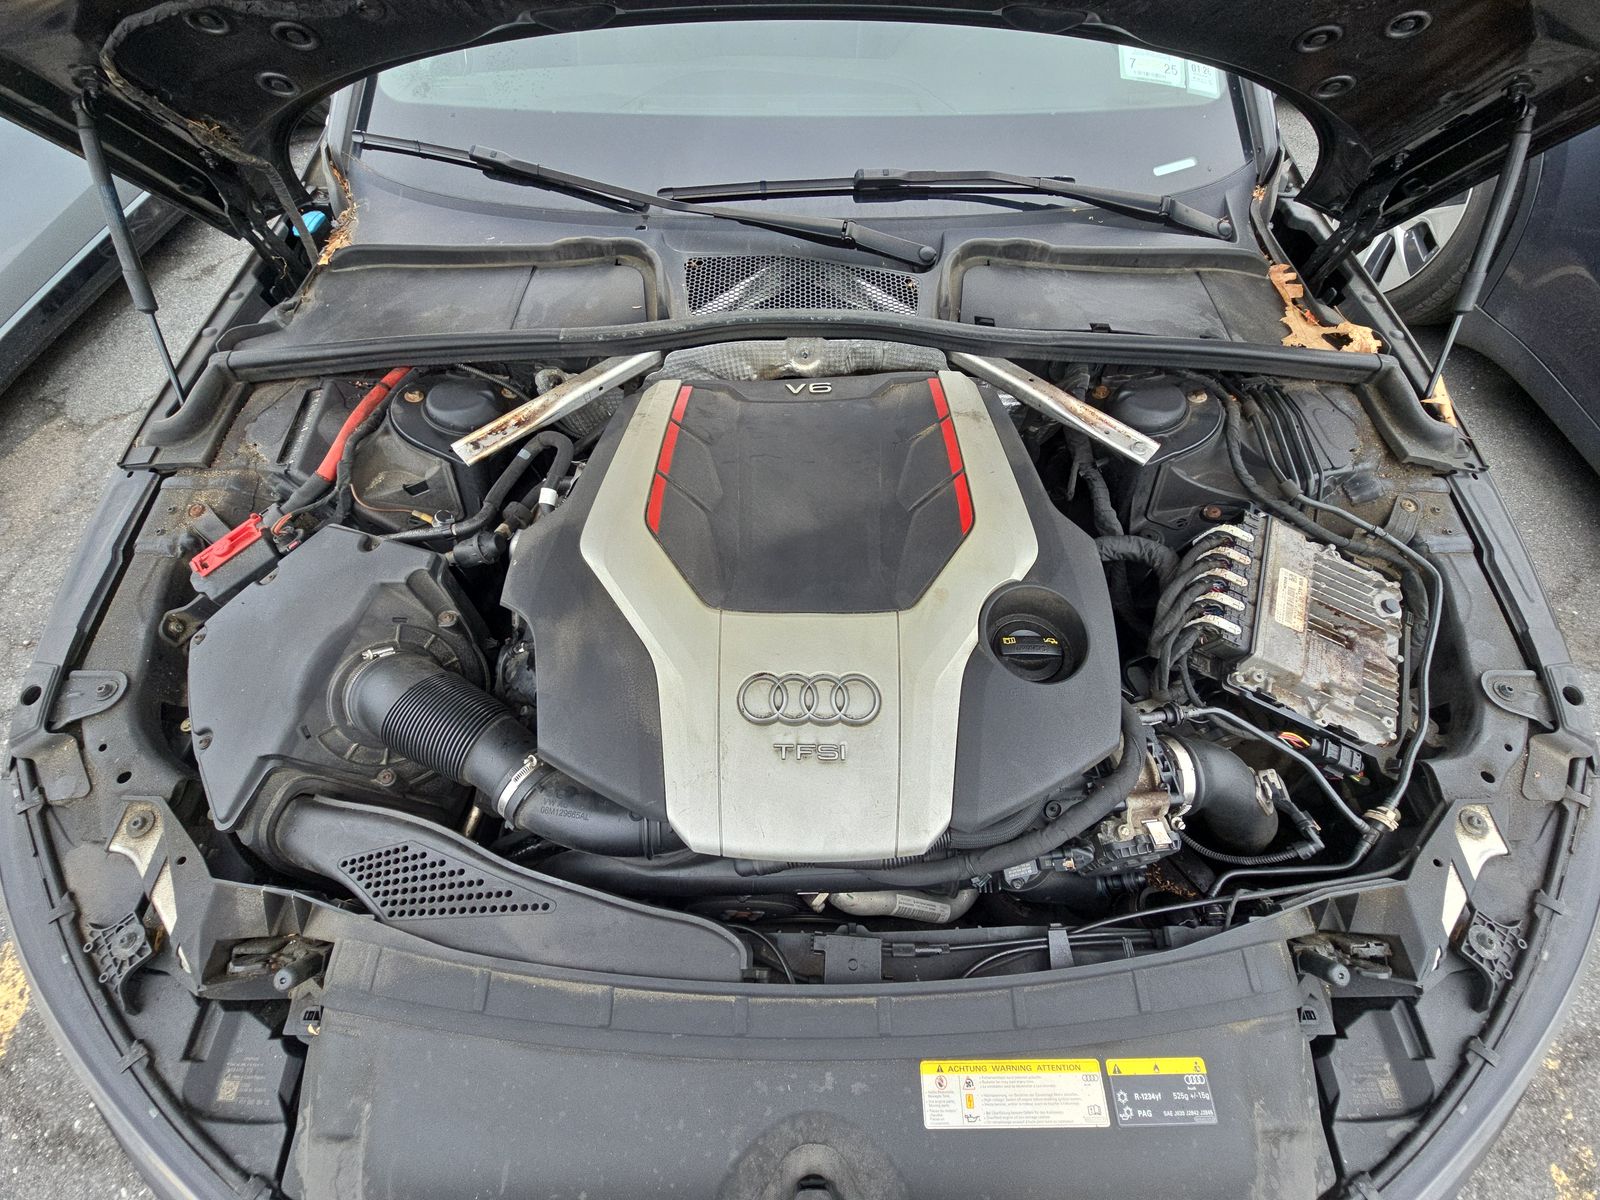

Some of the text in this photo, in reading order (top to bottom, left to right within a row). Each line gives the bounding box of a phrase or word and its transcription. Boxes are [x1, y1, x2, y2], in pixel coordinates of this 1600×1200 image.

[1164, 63, 1178, 76] 25
[785, 382, 832, 394] V6
[773, 743, 846, 761] TFSI
[948, 1065, 987, 1073] ACHTUNG
[1036, 1064, 1082, 1072] ATTENTION
[1134, 1092, 1162, 1101] R-1234yf
[1137, 1110, 1153, 1118] PAG
